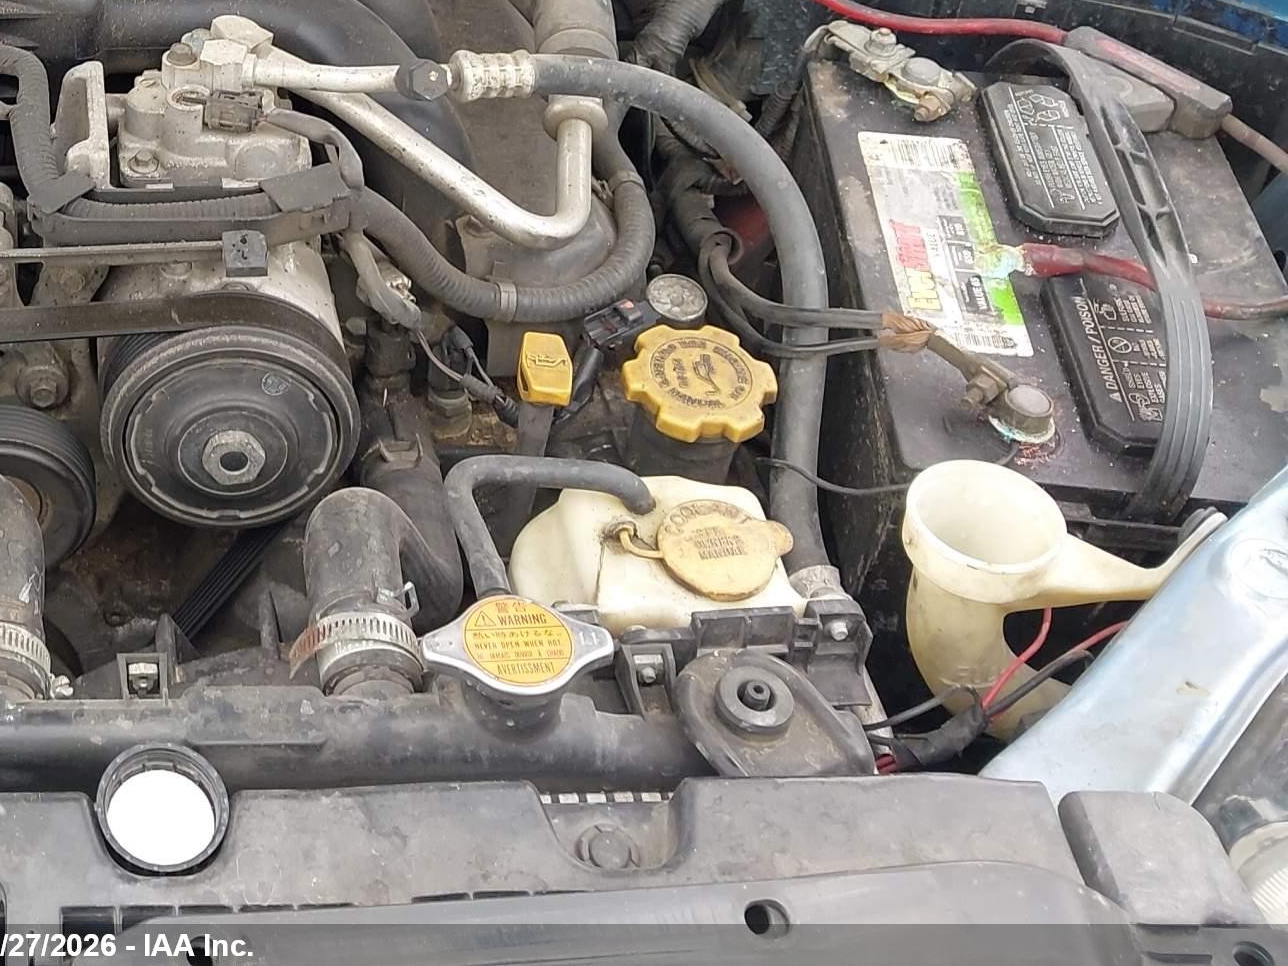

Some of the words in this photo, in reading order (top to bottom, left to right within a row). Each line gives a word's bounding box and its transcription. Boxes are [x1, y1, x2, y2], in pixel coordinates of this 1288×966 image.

[973, 287, 987, 310] VALUE
[1073, 296, 1098, 335] POISON
[1092, 344, 1118, 390] DANGER
[498, 614, 547, 626] WARNING
[475, 642, 497, 650] NEVER
[500, 641, 522, 649] OPEN
[497, 661, 556, 676] AVERTISSMENT
